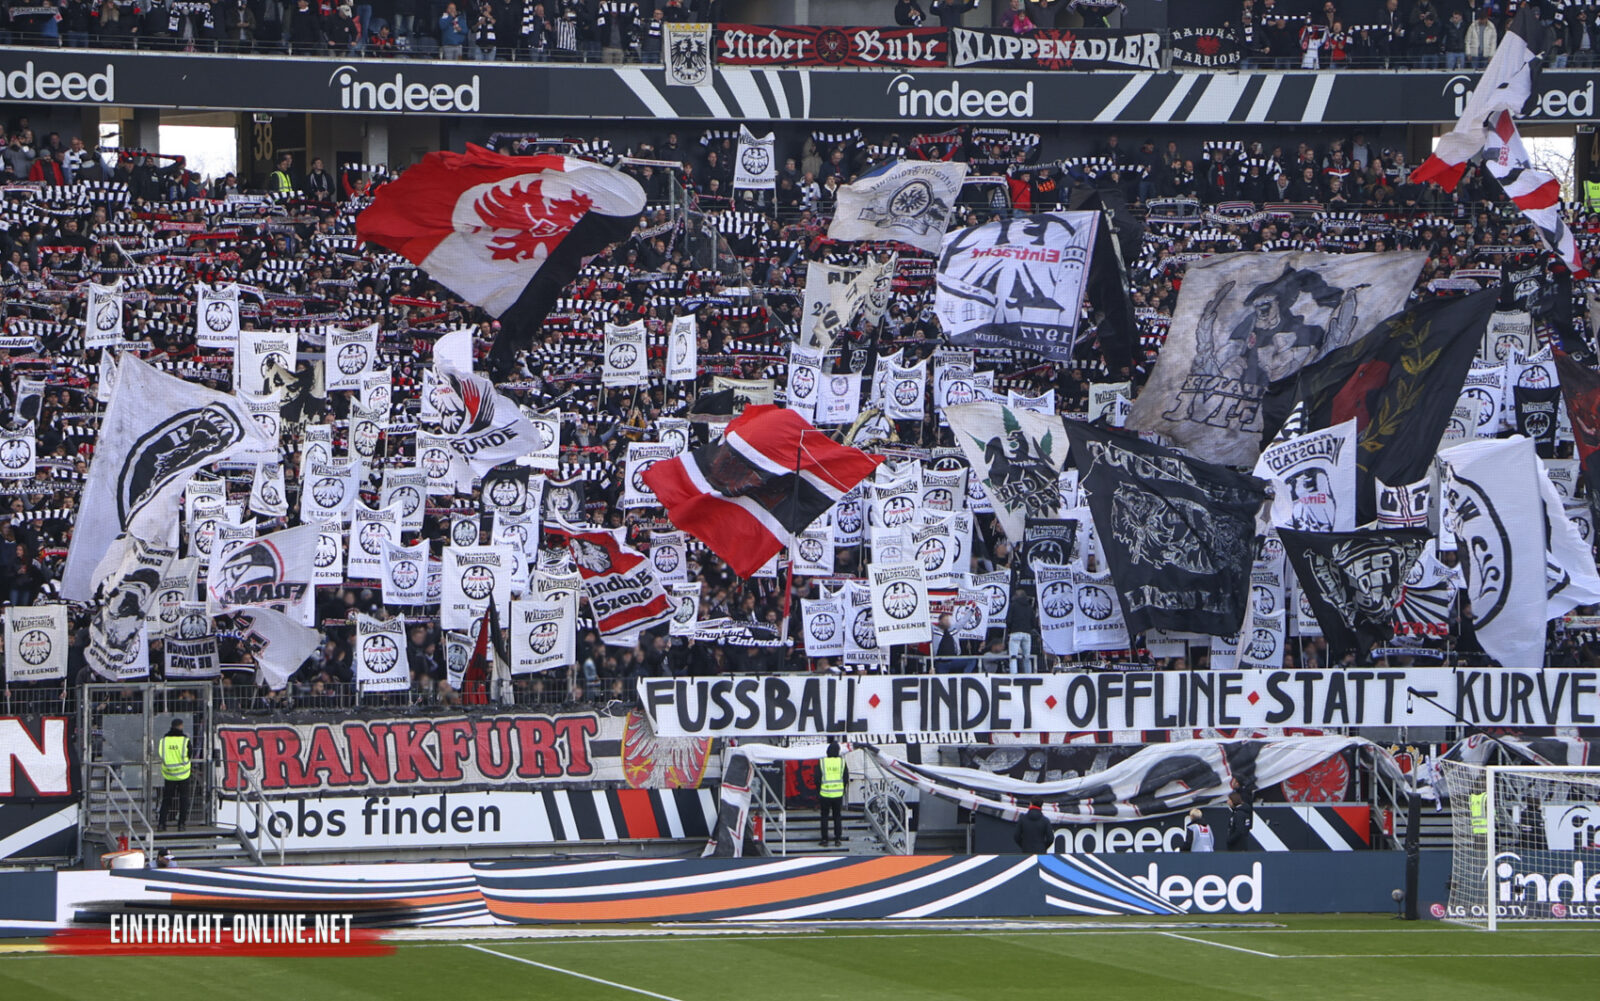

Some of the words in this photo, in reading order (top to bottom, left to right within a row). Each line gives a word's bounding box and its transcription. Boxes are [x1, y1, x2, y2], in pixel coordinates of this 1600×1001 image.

[722, 29, 812, 60] Nieder
[854, 29, 940, 62] Bube
[953, 27, 1160, 70] KLIPPENADLER
[0, 60, 115, 102] deed
[333, 68, 480, 112] indeed
[889, 76, 1035, 118] indeed
[254, 122, 273, 161] 38
[586, 568, 653, 598] inding
[874, 569, 922, 586] WALDSTADION
[593, 586, 653, 617] Szene
[12, 617, 56, 633] WALDSTADION
[878, 625, 890, 633] DIE
[892, 621, 927, 632] LEGENDE
[27, 666, 59, 675] LEGENDE
[646, 676, 869, 733] FUSSBALL
[891, 676, 1044, 732] FINDET
[1066, 672, 1243, 730] OFFLINE
[1265, 670, 1406, 724] STATT
[1455, 669, 1598, 724] KURVE
[219, 713, 598, 791] FRANKFURT
[245, 800, 348, 839] Jobs
[361, 795, 501, 837] finden
[1050, 822, 1191, 853] ndeed
[1447, 905, 1466, 916] LG
[1471, 905, 1507, 916] OLD
[1509, 905, 1528, 916] TV
[1568, 905, 1588, 916] LG
